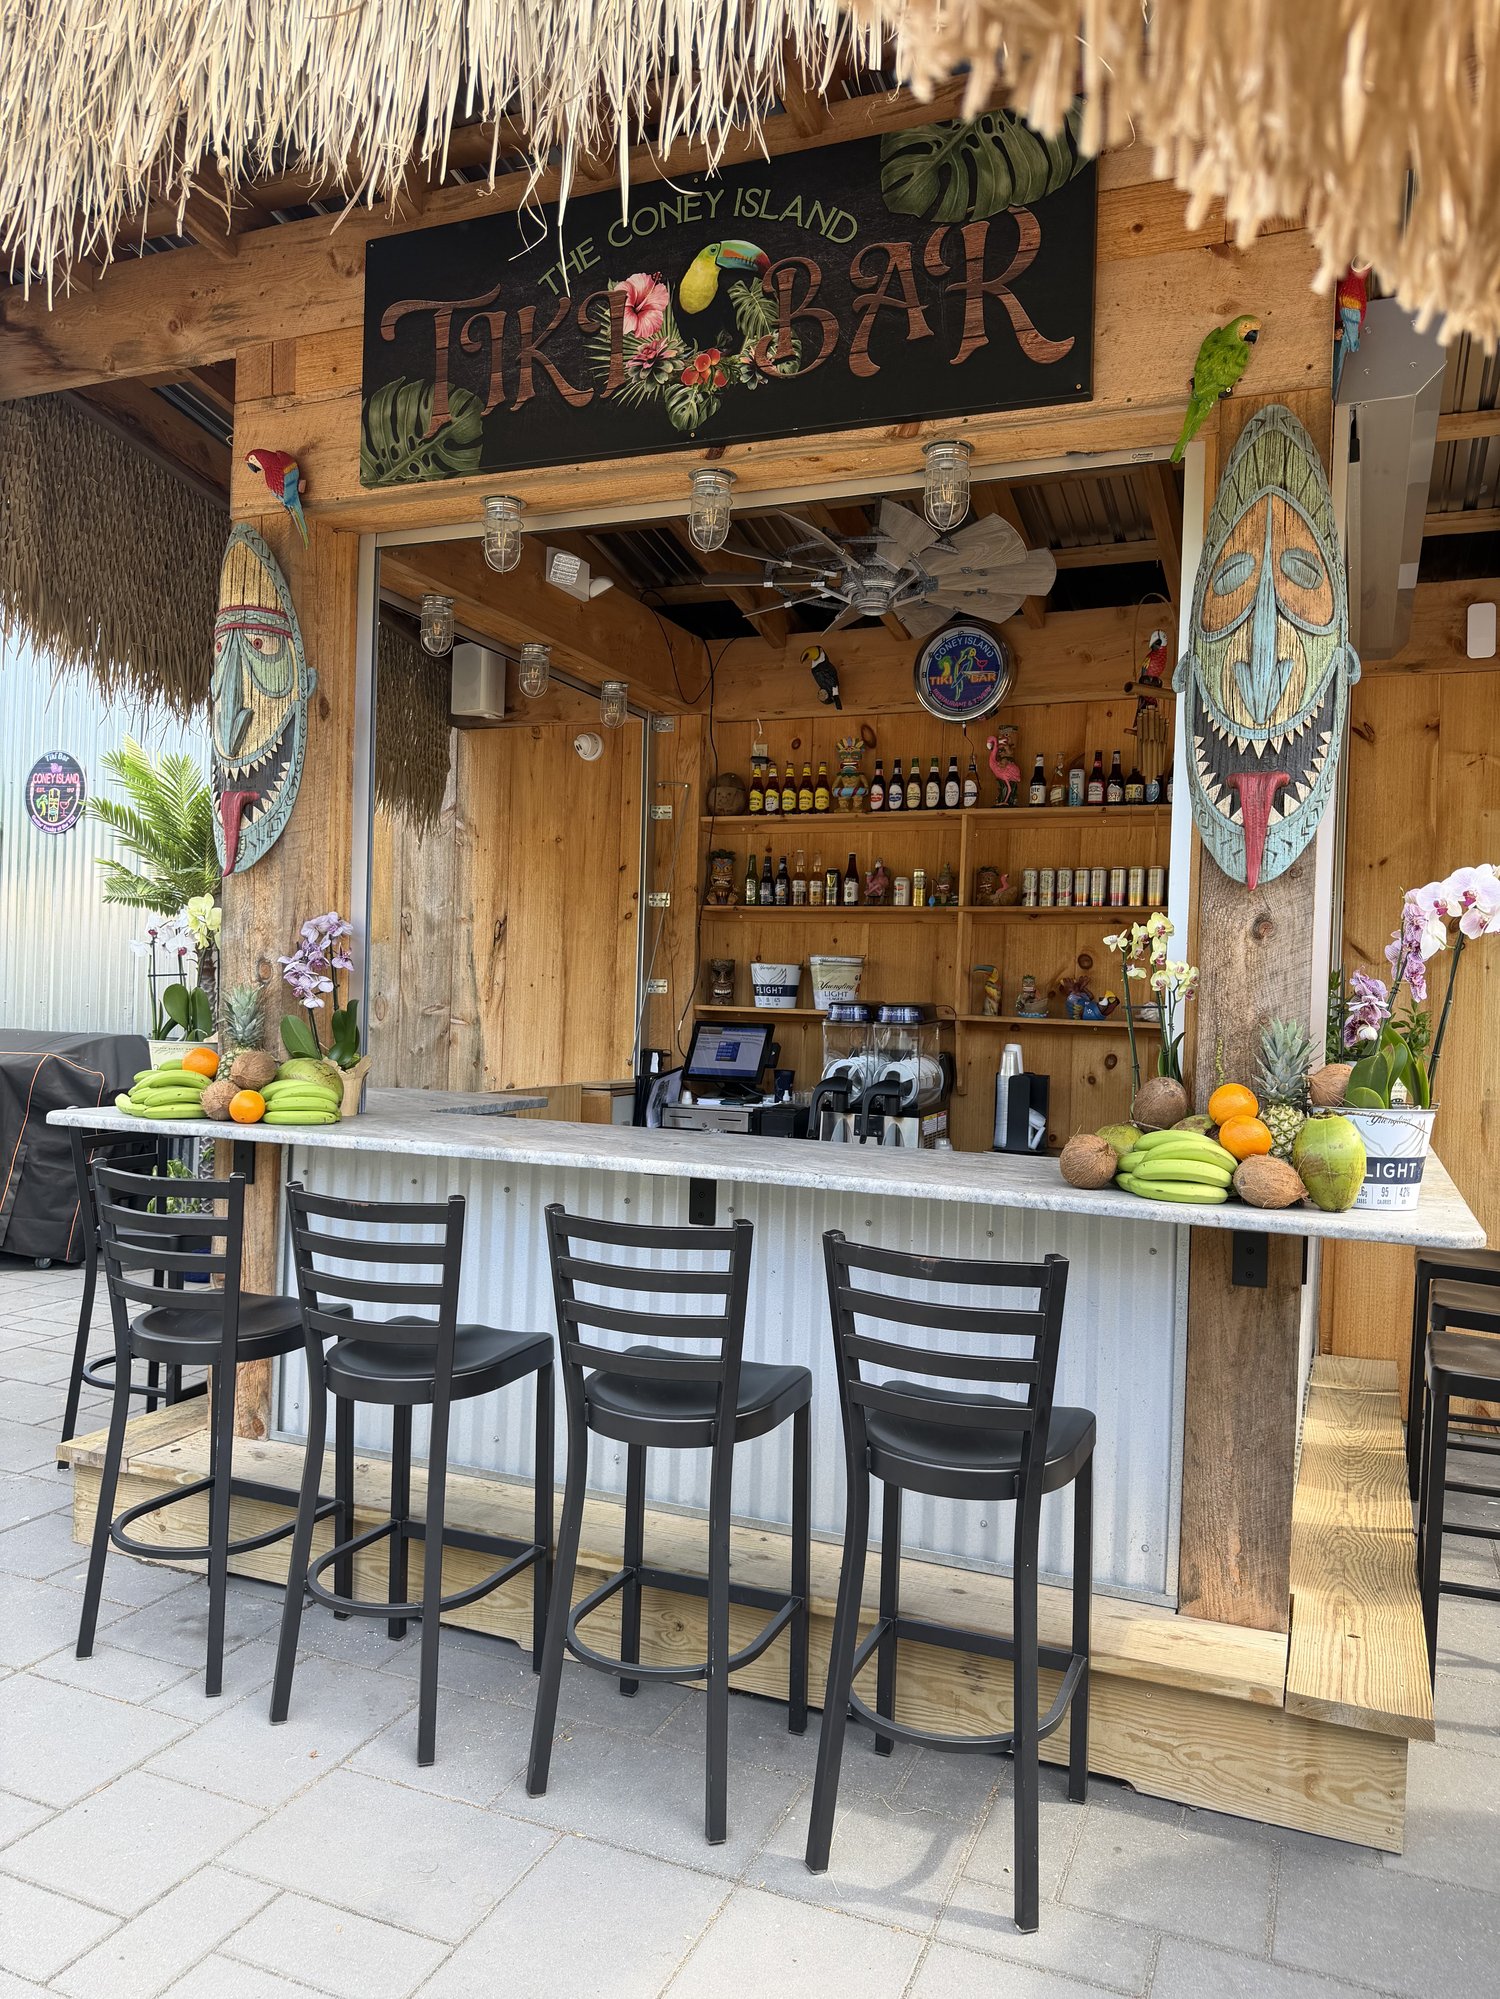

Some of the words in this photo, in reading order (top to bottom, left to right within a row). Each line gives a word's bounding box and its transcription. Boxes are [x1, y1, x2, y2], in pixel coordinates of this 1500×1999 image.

[537, 237, 601, 296] THE
[607, 188, 725, 248] CONEY
[733, 187, 859, 245] ISLAND
[380, 283, 628, 440] TIKI
[754, 204, 1076, 379] BAR
[934, 637, 963, 661] CONEY
[964, 636, 995, 658] ISLAND
[929, 675, 953, 686] TIKI
[970, 672, 997, 684] BAR
[58, 752, 70, 762] Bar
[32, 772, 56, 784] CONEY
[56, 772, 80, 784] ISLAND
[755, 986, 783, 994] FLIGHT
[818, 980, 855, 991] Yuengling
